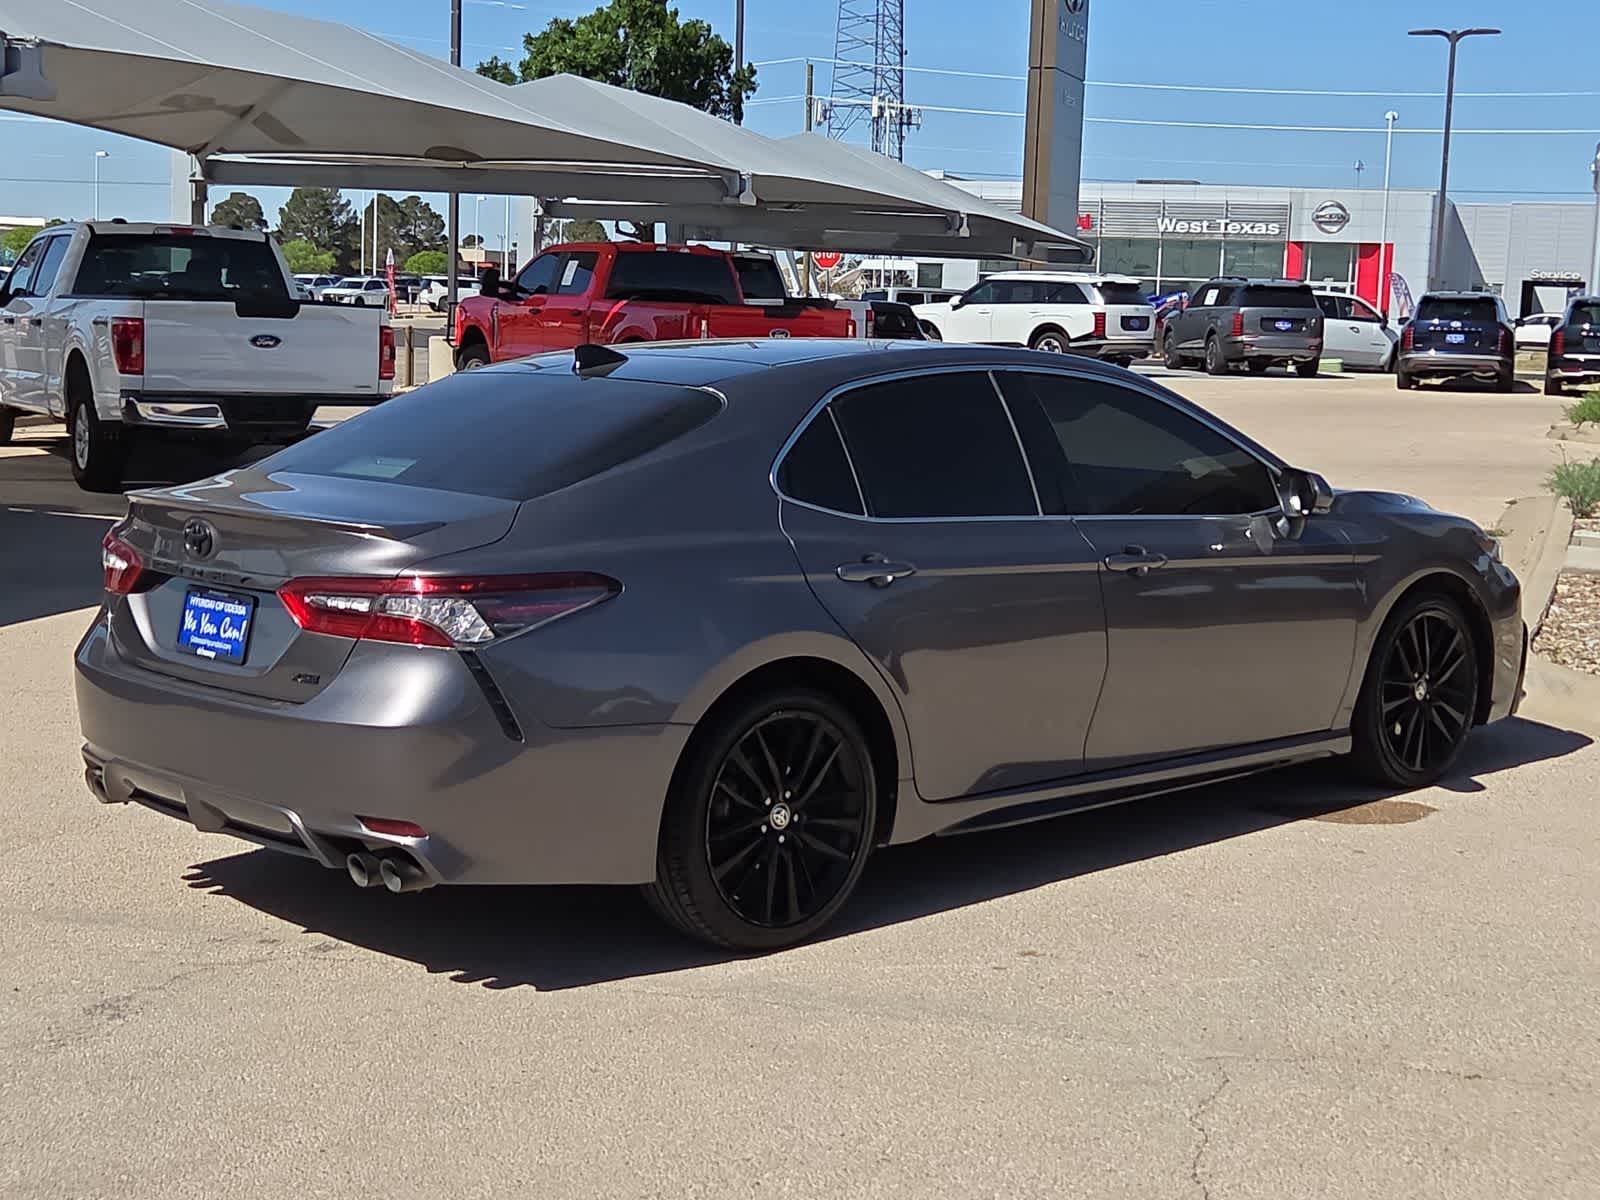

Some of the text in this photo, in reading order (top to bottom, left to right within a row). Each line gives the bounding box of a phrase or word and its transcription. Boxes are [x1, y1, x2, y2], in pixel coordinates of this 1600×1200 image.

[1156, 217, 1280, 236] West Texas
[1530, 268, 1581, 280] Service
[184, 608, 248, 642] Yes You Can!
